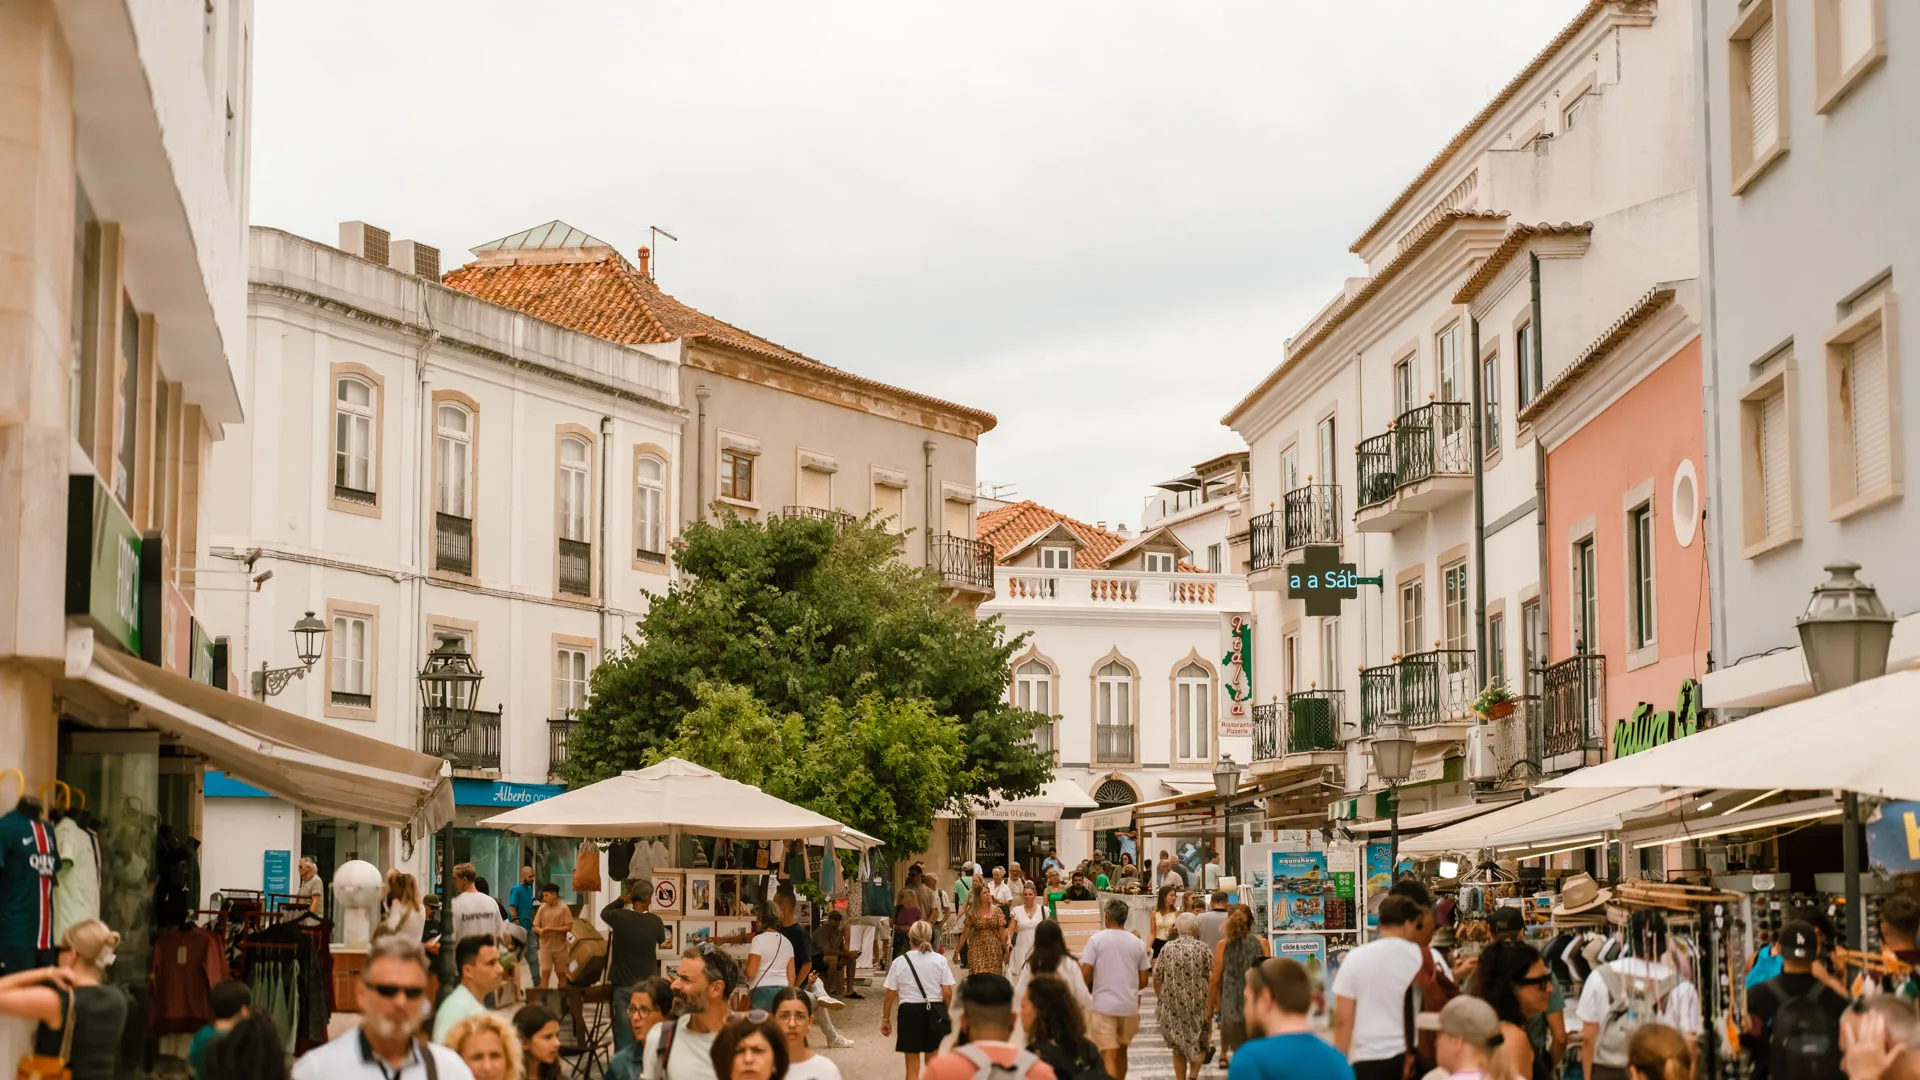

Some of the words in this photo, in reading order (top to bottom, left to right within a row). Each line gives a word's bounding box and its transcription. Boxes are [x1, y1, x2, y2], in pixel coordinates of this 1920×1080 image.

[1290, 574, 1300, 589] a
[1308, 574, 1318, 589] a
[1325, 569, 1357, 588] Sáb
[1230, 615, 1245, 716] Italia
[493, 785, 532, 803] Alberto
[978, 839, 987, 849] R
[1279, 857, 1316, 865] aquashow
[1300, 943, 1319, 951] splash
